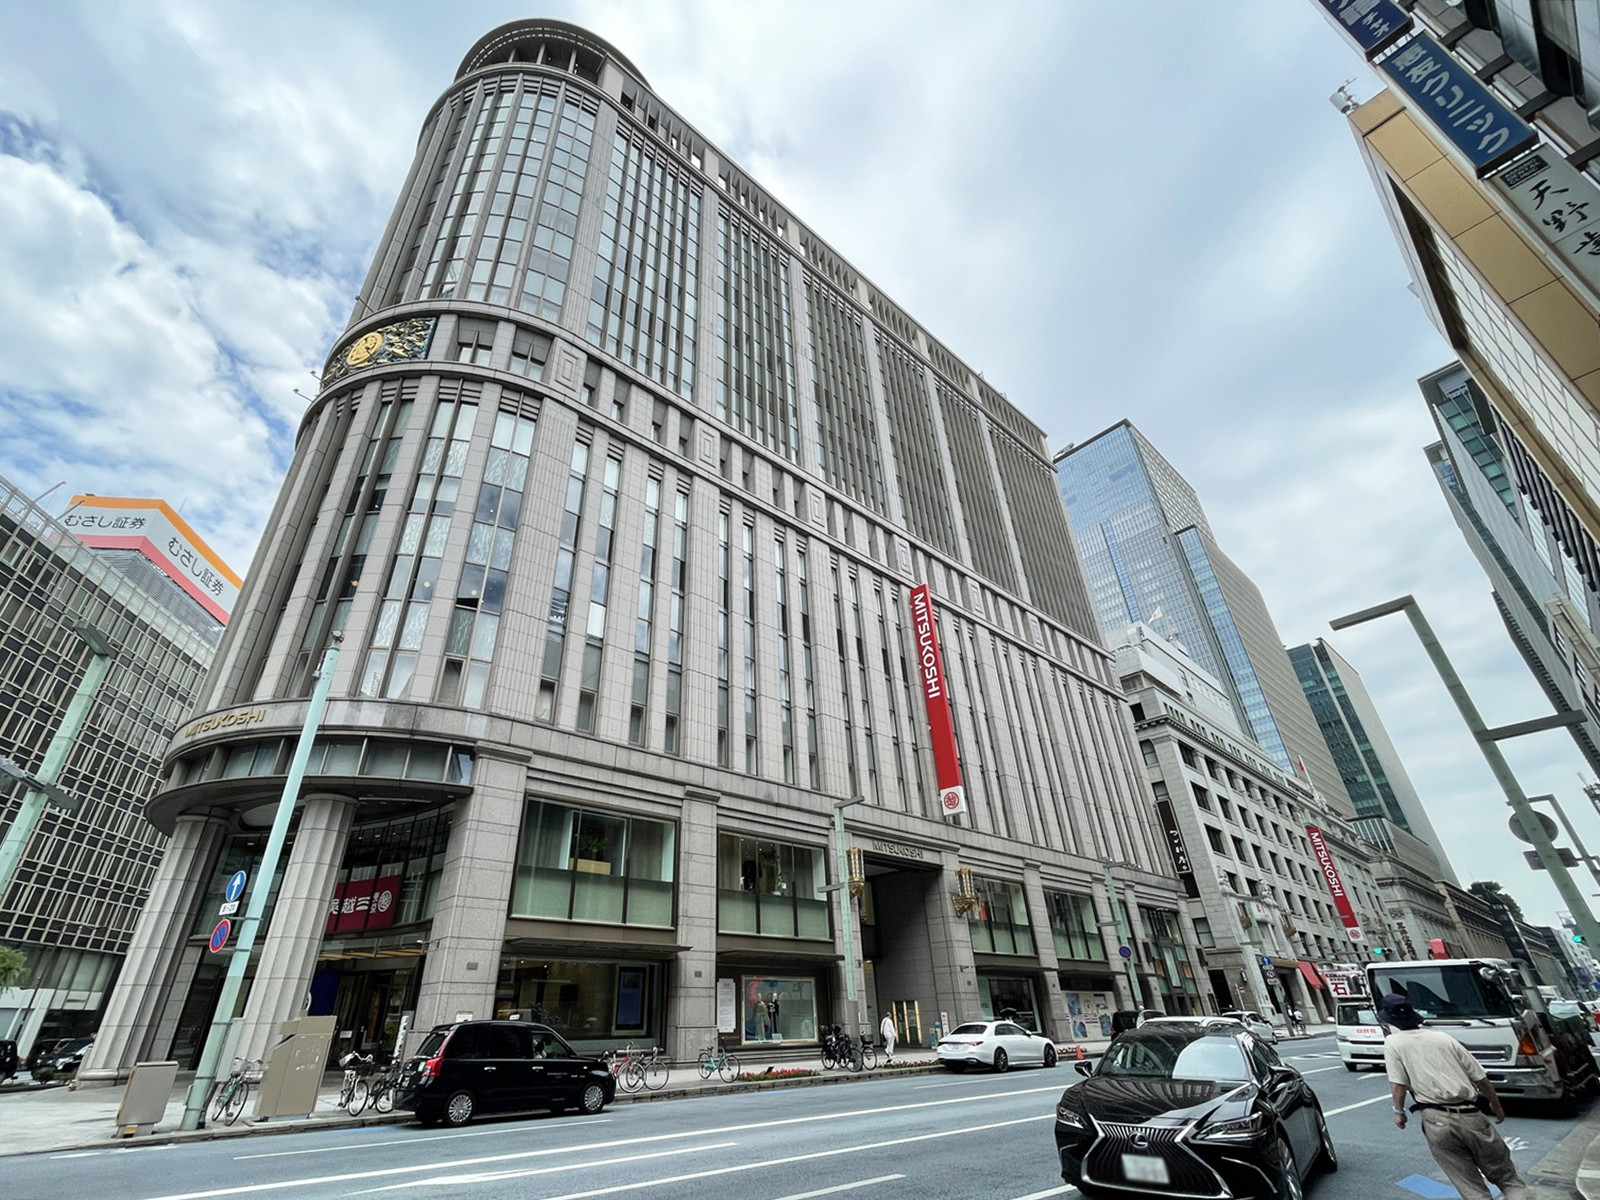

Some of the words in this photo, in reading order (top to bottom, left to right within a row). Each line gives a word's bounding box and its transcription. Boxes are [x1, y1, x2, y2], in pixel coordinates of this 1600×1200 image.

[64, 514, 146, 530] むさし証券
[168, 536, 225, 596] むさし証券
[913, 592, 940, 699] MITSUKOSHI
[185, 709, 266, 738] MITSUKOSHI
[872, 841, 924, 859] MITSUKOSHI
[1311, 831, 1344, 897] MITSUKOSHI
